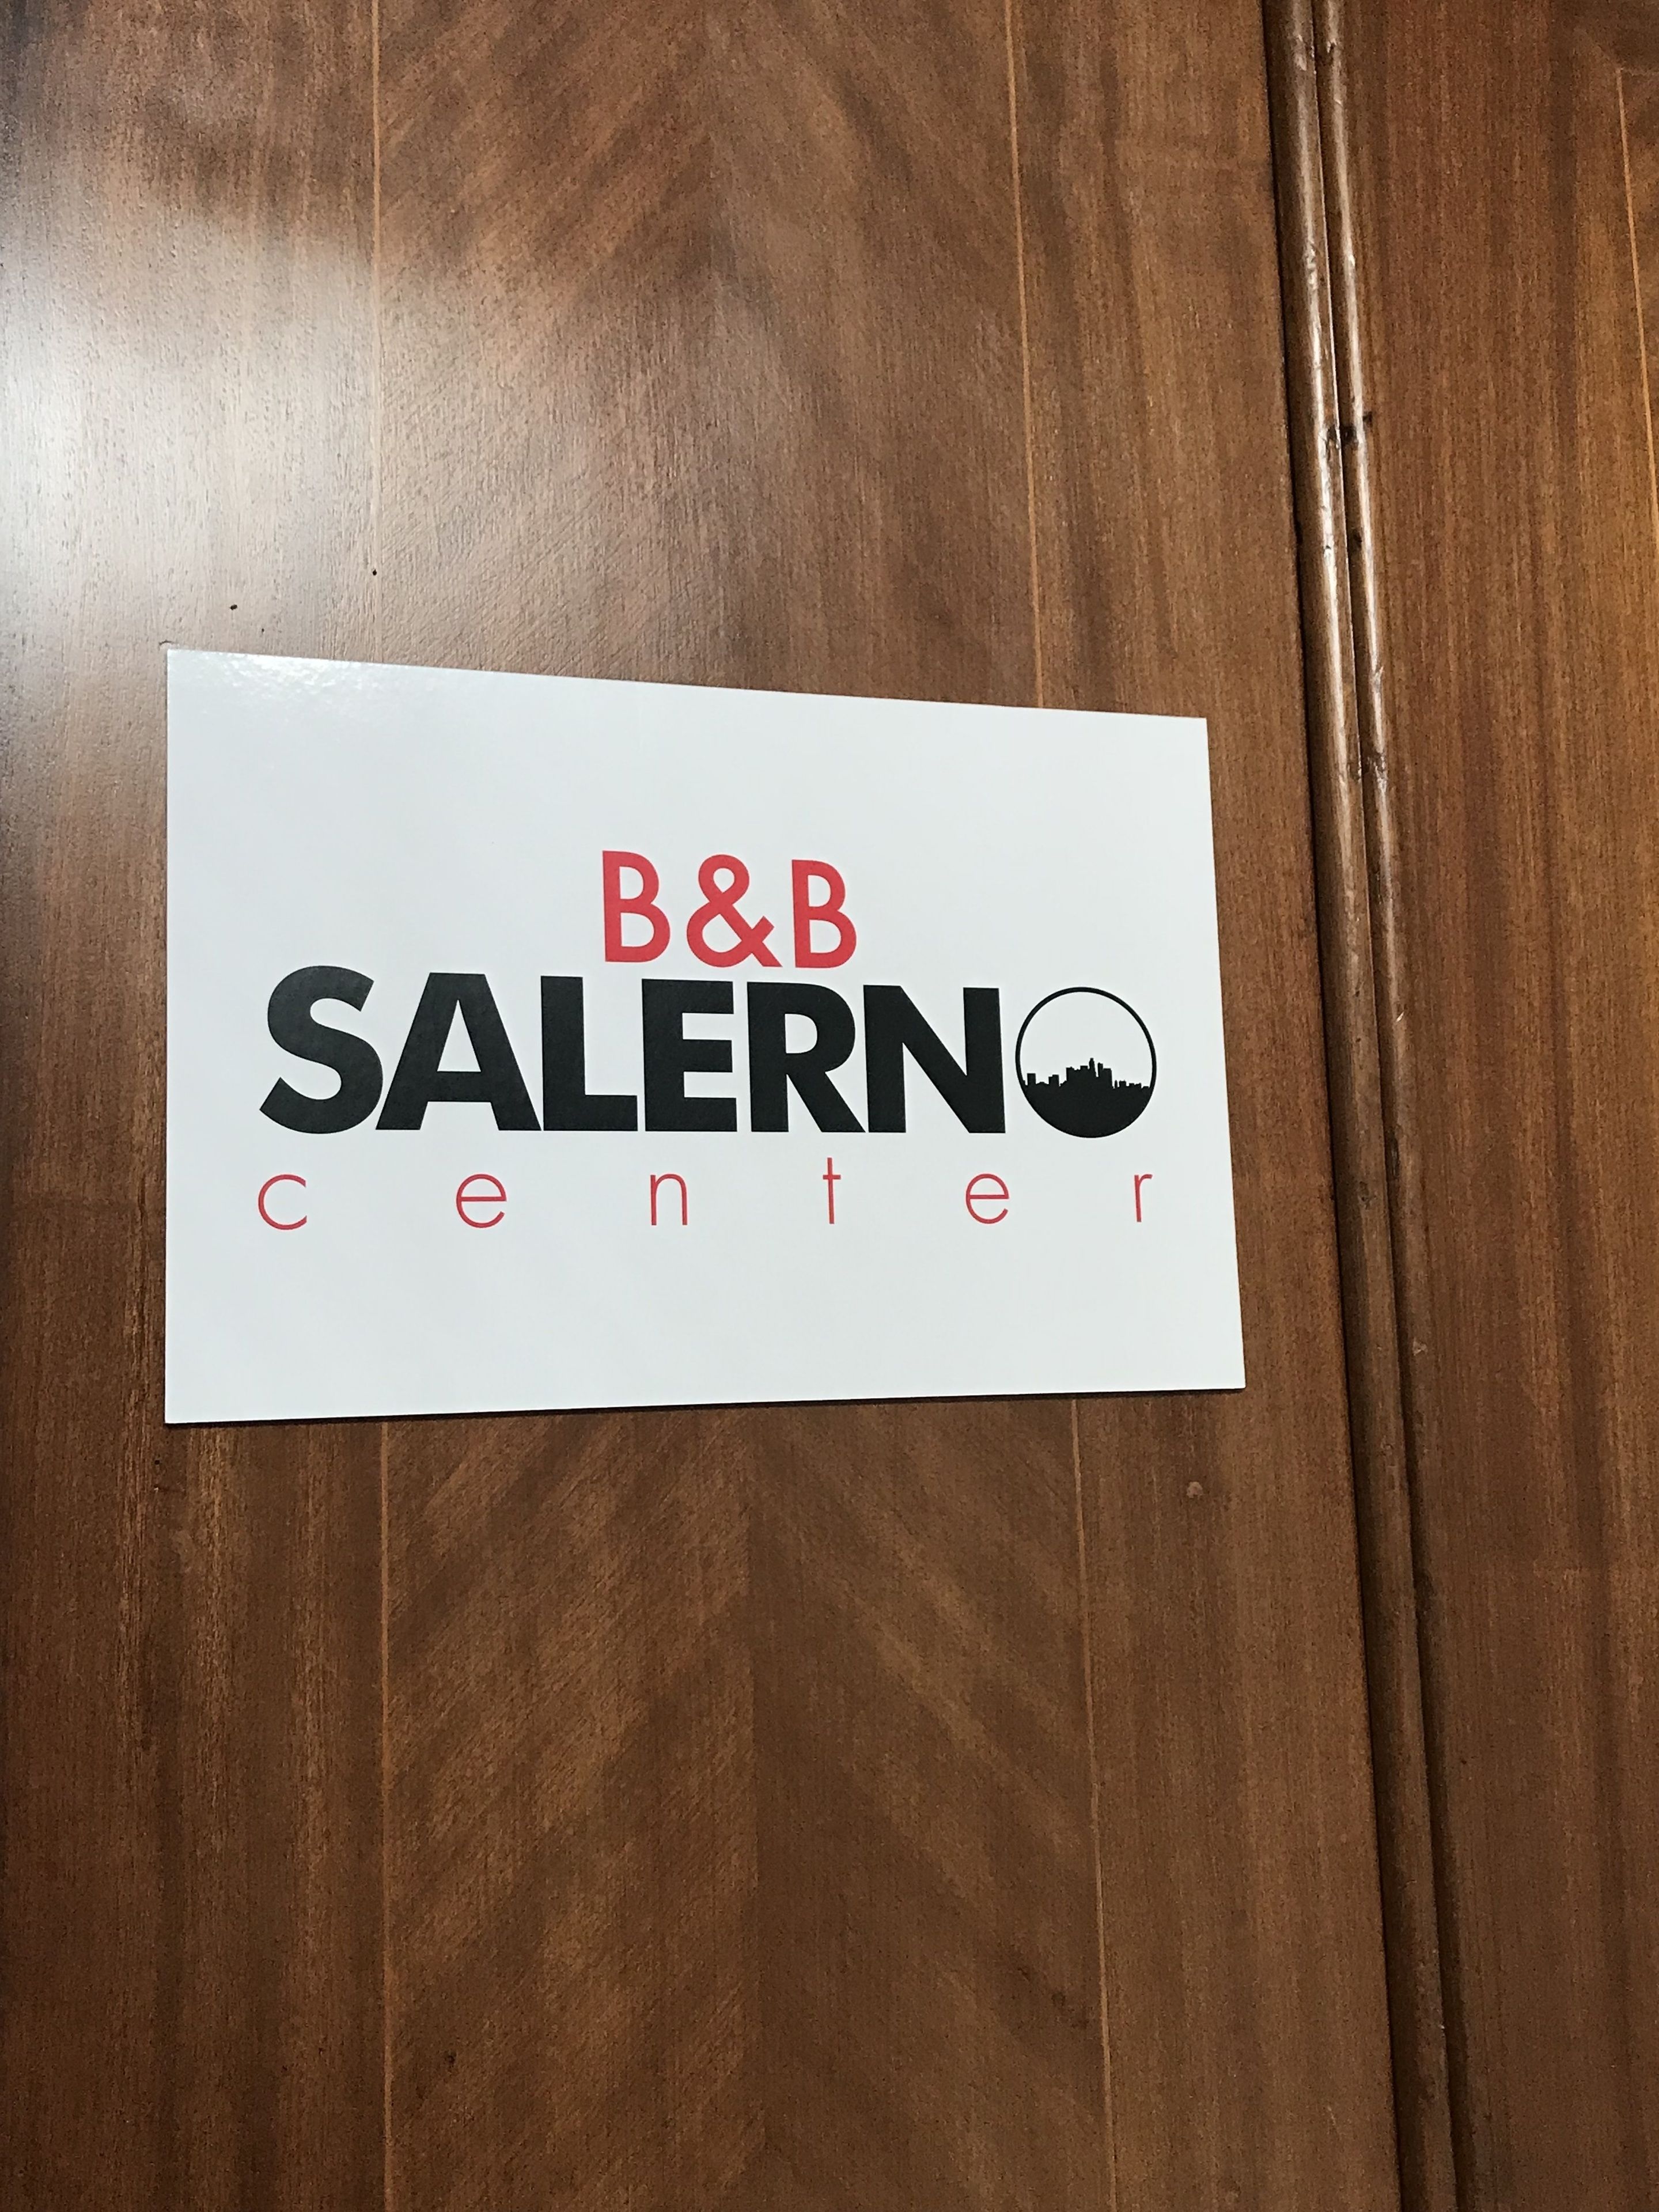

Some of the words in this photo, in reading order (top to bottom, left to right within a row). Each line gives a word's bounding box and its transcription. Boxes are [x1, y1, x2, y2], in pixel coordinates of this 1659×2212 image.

[601, 850, 858, 970] B&B
[259, 965, 1157, 1138] SALERNO
[257, 1157, 1153, 1231] center
